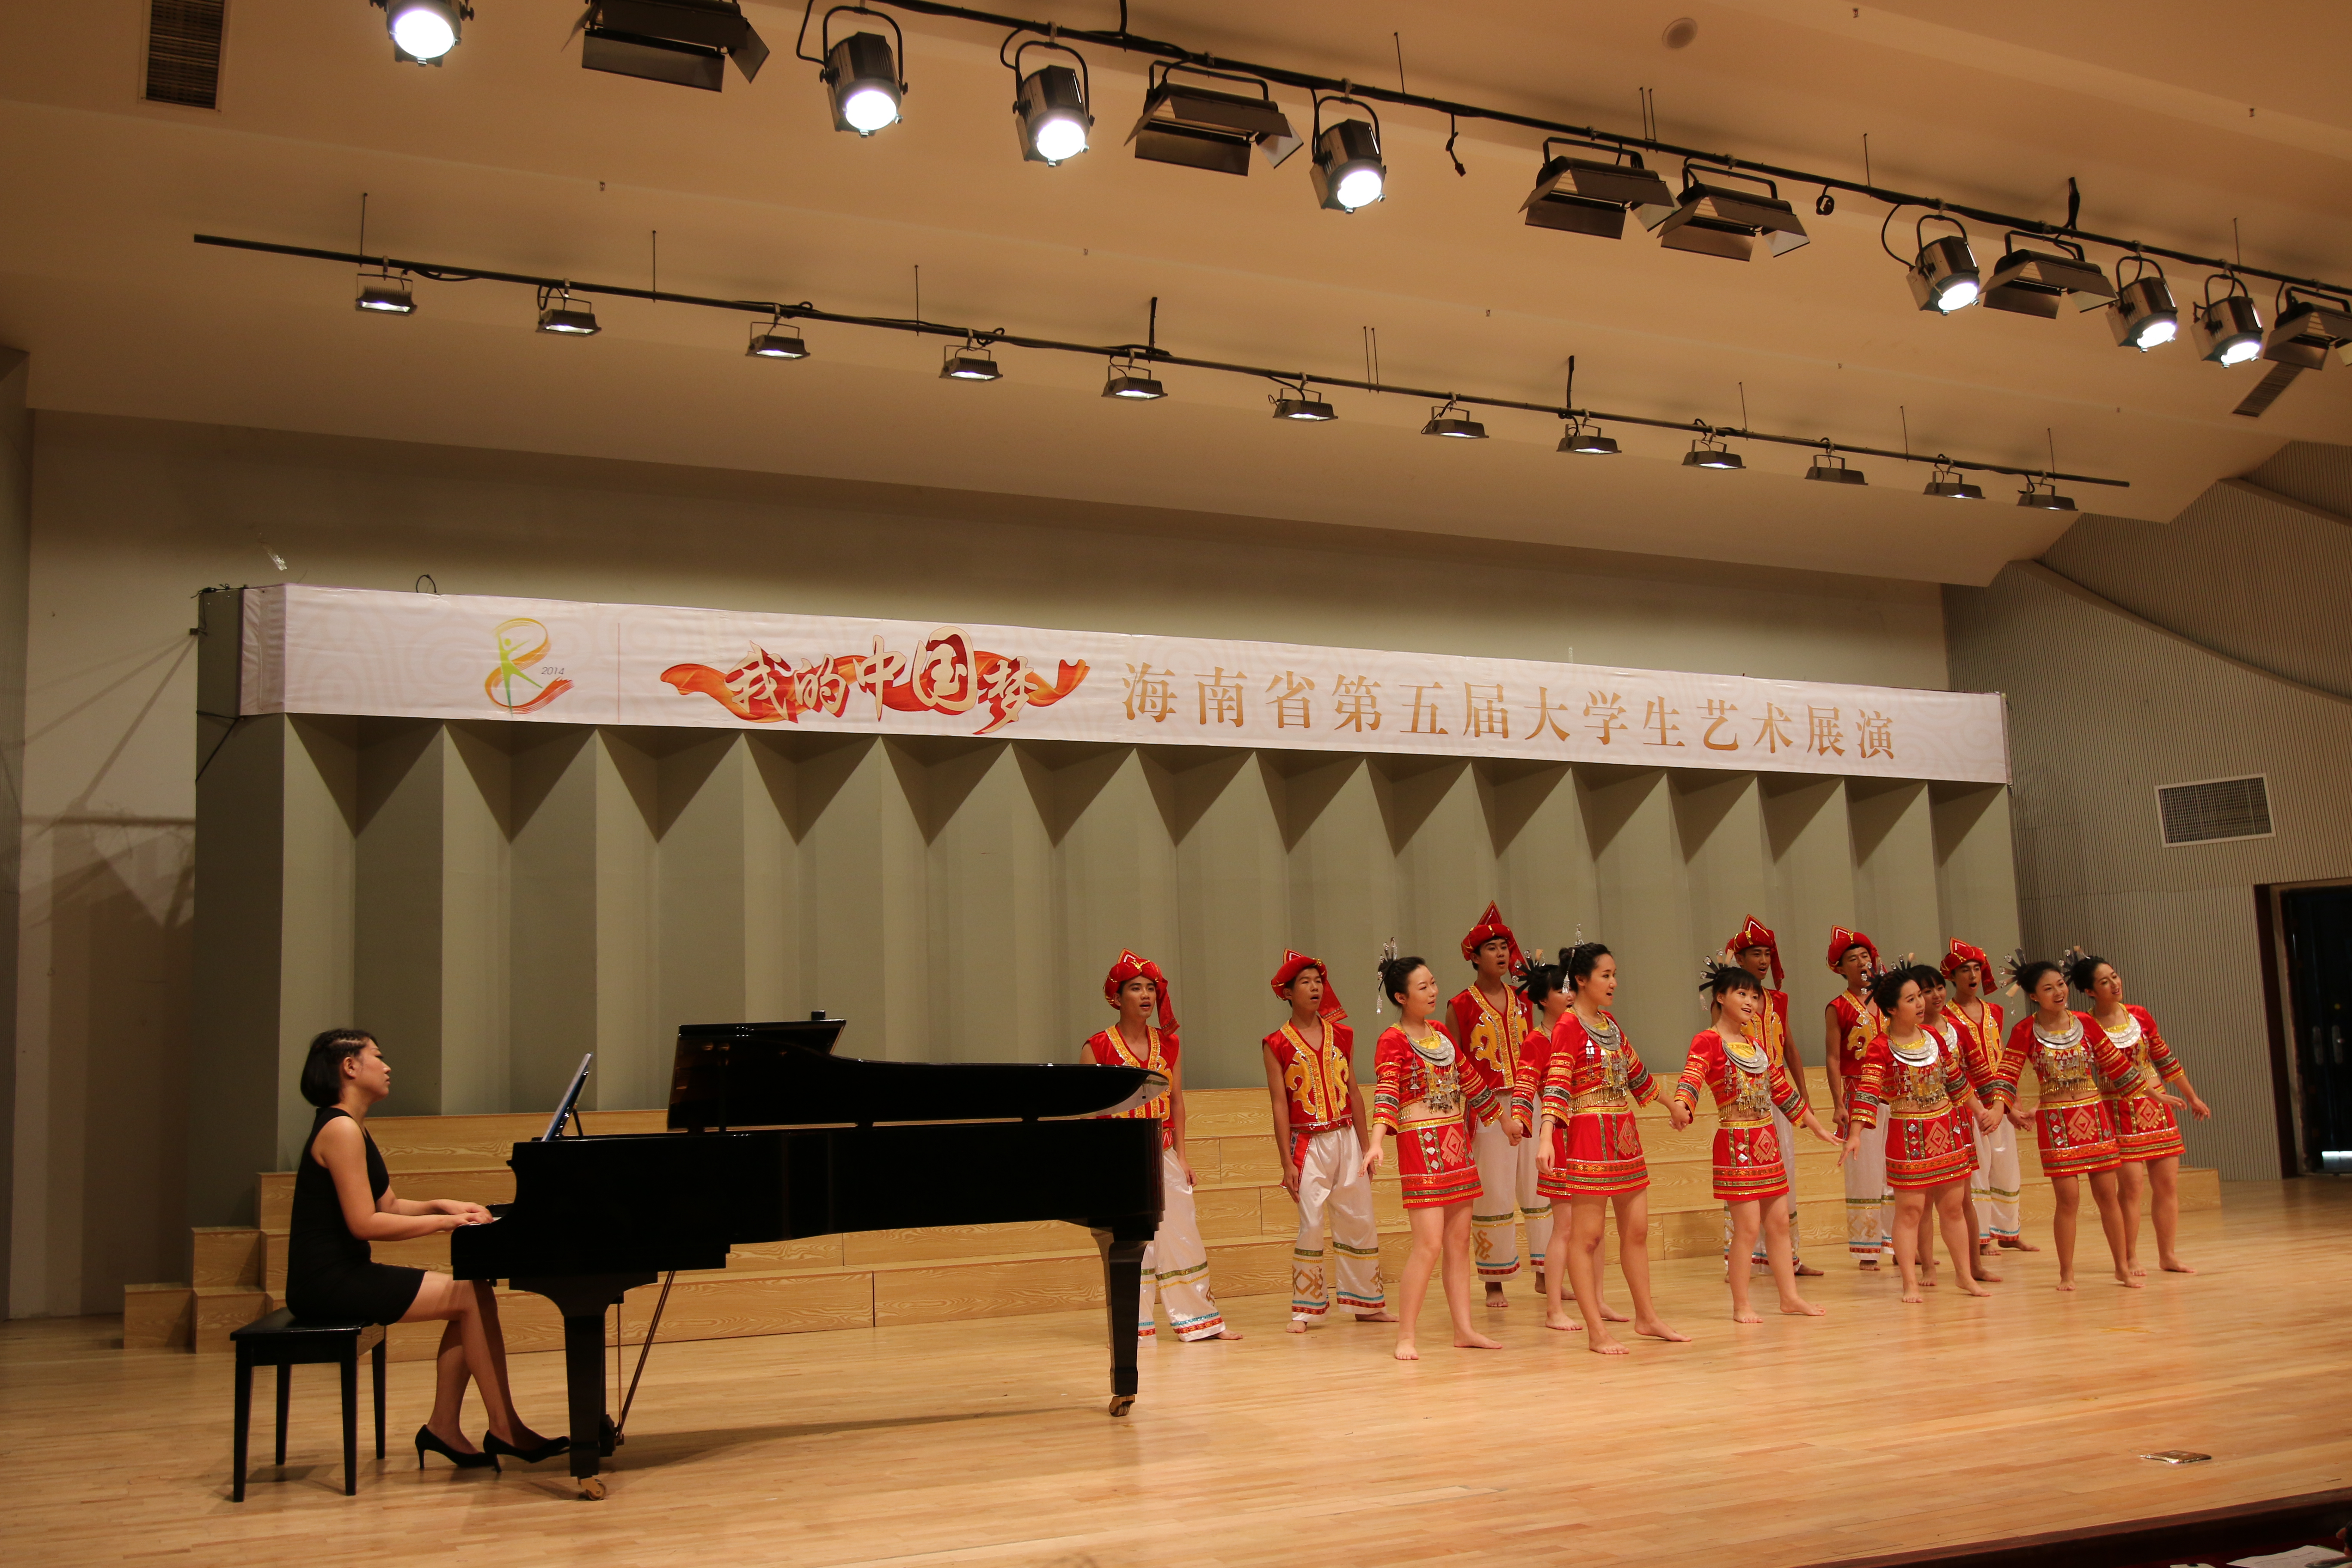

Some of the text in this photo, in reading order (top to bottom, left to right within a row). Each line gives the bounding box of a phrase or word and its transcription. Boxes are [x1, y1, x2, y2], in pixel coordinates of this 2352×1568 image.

[541, 666, 564, 675] 2014
[725, 626, 1039, 735] 我的中国梦
[1121, 662, 1894, 760] 海南省第五届大学生艺术展演
